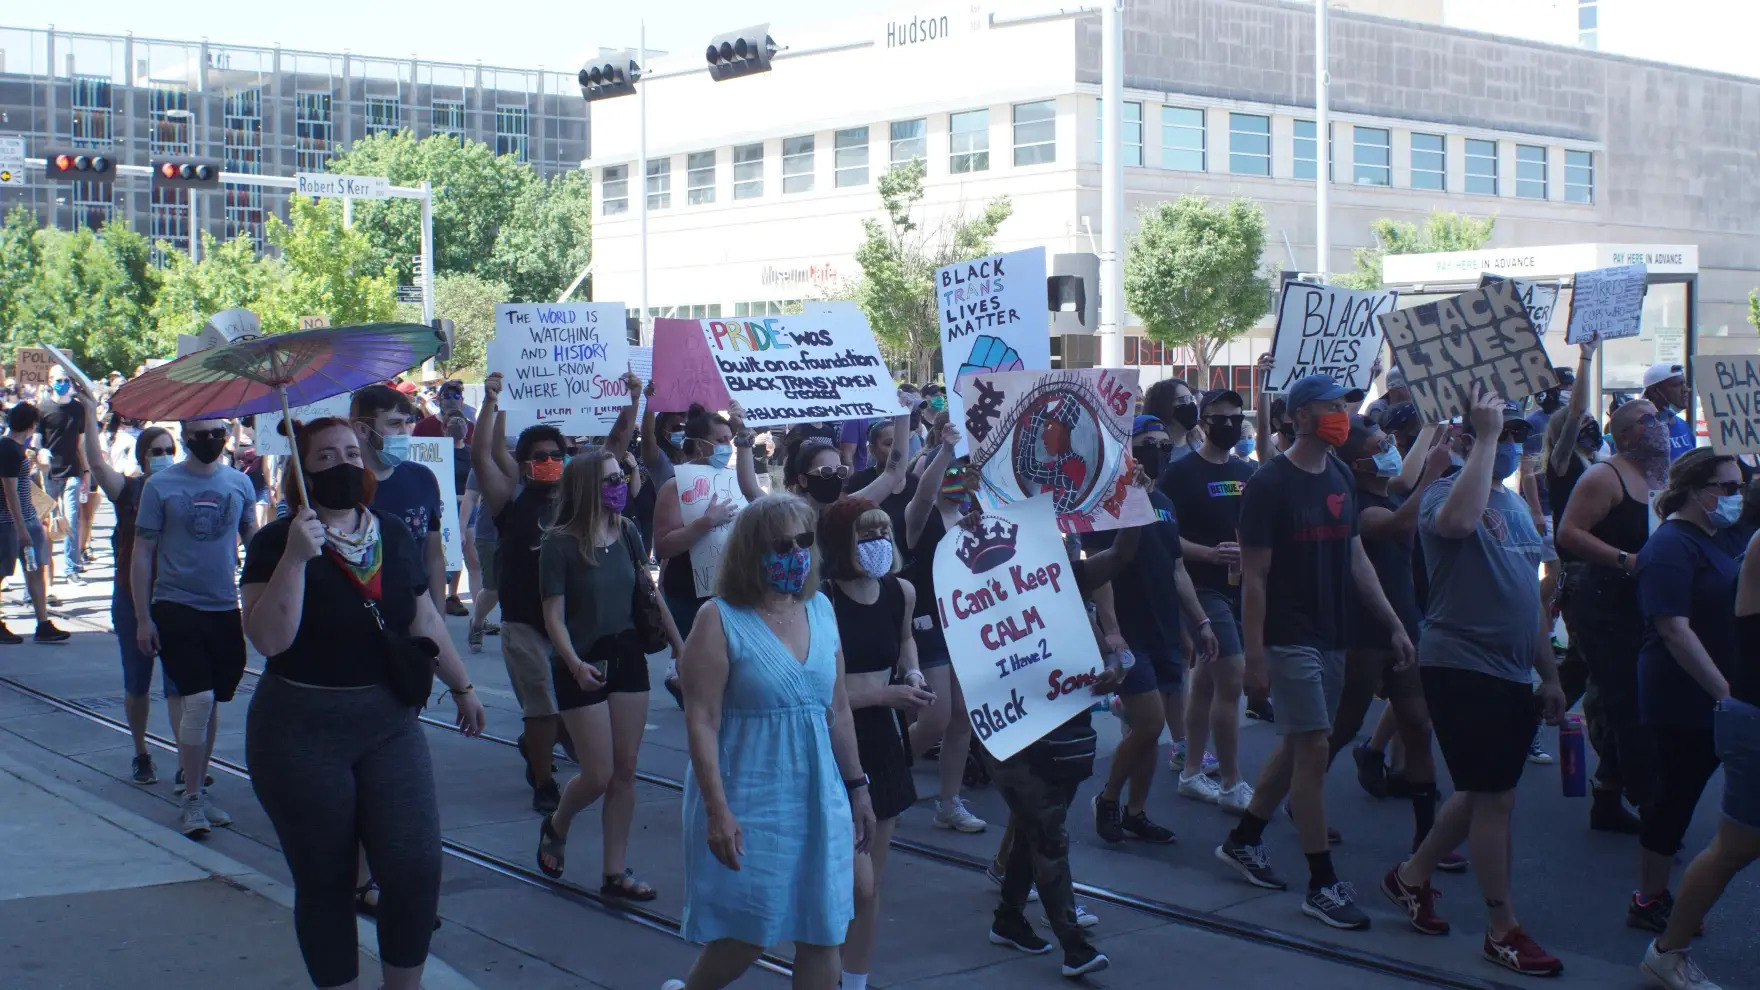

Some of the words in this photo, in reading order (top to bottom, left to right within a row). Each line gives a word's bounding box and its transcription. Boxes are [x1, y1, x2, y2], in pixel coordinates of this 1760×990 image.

[888, 15, 948, 48] Hudson
[300, 177, 334, 193] Robert
[338, 179, 345, 194] S
[347, 180, 369, 195] Kerr
[942, 257, 1005, 288] BLACK
[1481, 260, 1490, 269] IN
[1494, 256, 1536, 269] ADVANCE
[1613, 253, 1625, 264] PAY
[1627, 253, 1644, 264] HERE
[1646, 253, 1653, 264] IN
[1654, 253, 1683, 264] ADVANCE
[944, 278, 1004, 307] TRANS
[304, 318, 324, 330] NO
[505, 310, 532, 325] THE
[536, 307, 577, 324] WORLD
[586, 310, 598, 324] IS
[946, 295, 1001, 324] LIVES
[1302, 290, 1388, 338] BLACK
[1382, 281, 1523, 348] BLACK
[529, 326, 599, 344] WATCHING
[709, 318, 790, 352] PRIDE
[789, 329, 834, 347] was
[948, 308, 1021, 343] MATTER
[520, 348, 548, 360] AND
[554, 342, 609, 362] HISTORY
[715, 354, 765, 374] built
[764, 358, 790, 373] on
[788, 358, 802, 371] a
[799, 348, 880, 371] foundation
[1101, 338, 1197, 365] USEUM
[1296, 338, 1361, 366] LIVES
[1396, 316, 1537, 382] LIVES
[515, 365, 555, 380] WILL
[558, 361, 595, 377] KNOW
[724, 374, 782, 392] BLACK
[775, 374, 830, 391] TRANS
[826, 373, 878, 389] WOMEN
[1715, 359, 1760, 390] BLA
[507, 382, 560, 401] WHERE
[564, 376, 590, 398] YOU
[590, 374, 629, 400] STOOD
[1410, 350, 1559, 425] MATTER
[938, 597, 949, 629] I
[952, 577, 1009, 620] Can't
[1008, 562, 1061, 595] Keep
[980, 606, 1046, 650] CALM
[995, 655, 1010, 679] I
[1009, 650, 1041, 672] Have
[1038, 638, 1053, 660] 2
[969, 688, 1029, 742] Black
